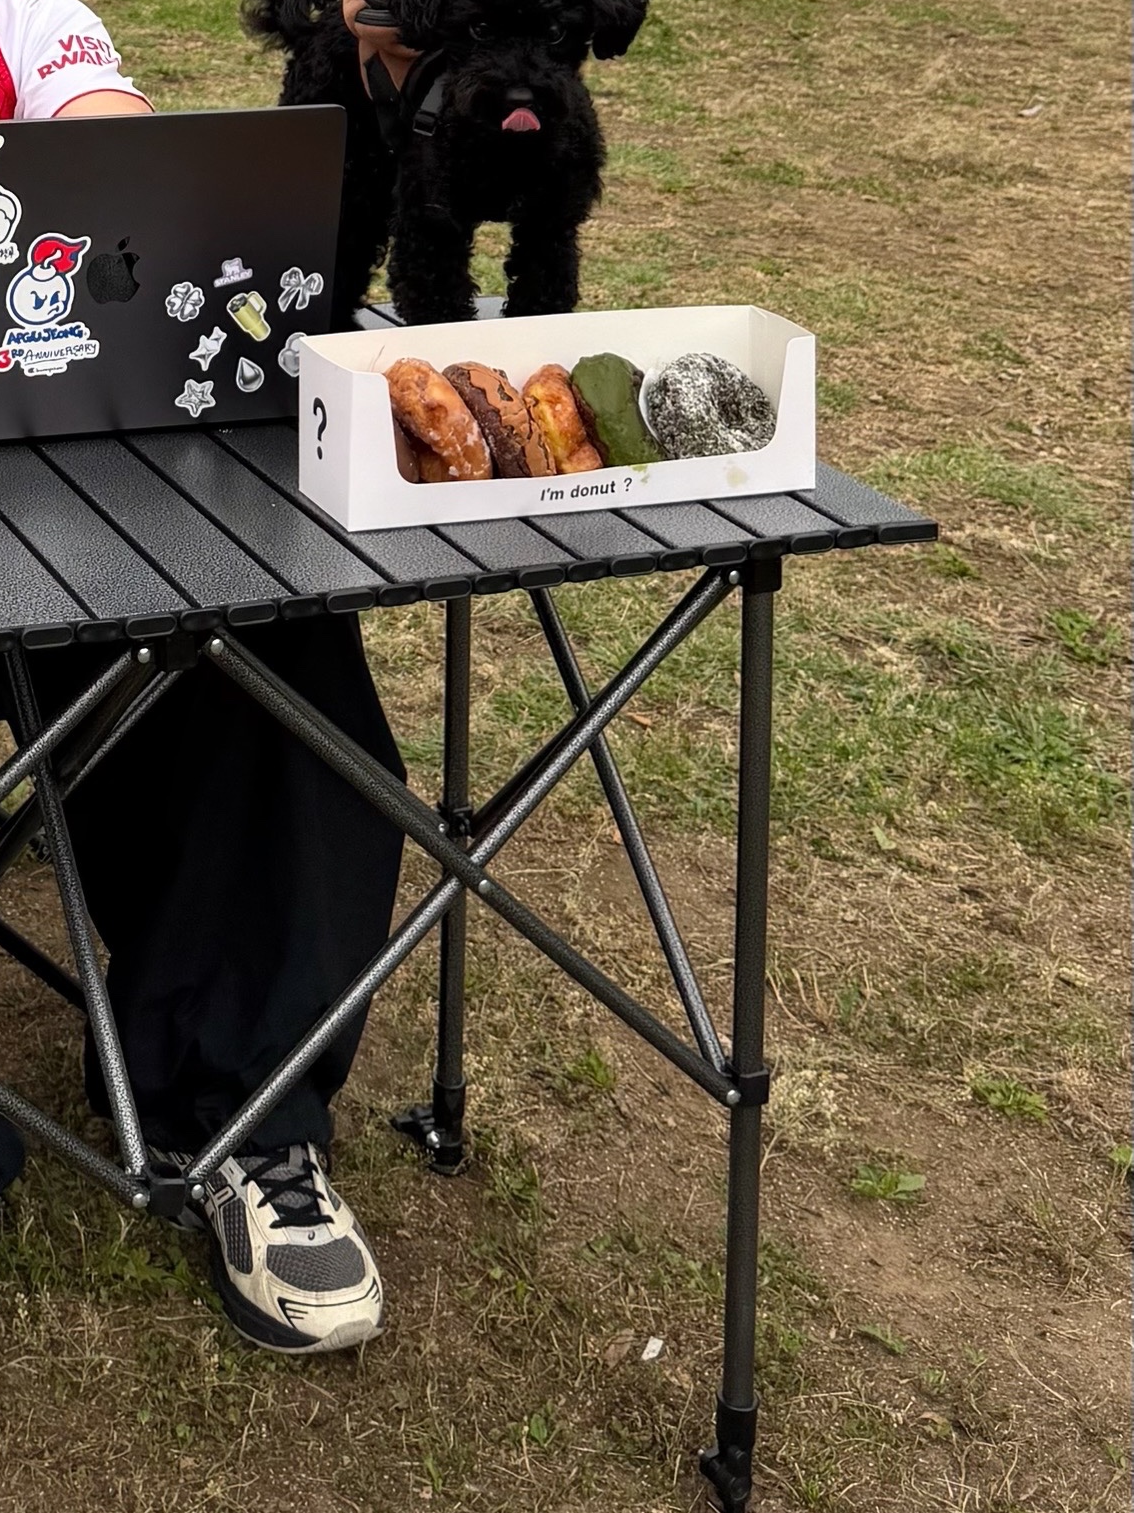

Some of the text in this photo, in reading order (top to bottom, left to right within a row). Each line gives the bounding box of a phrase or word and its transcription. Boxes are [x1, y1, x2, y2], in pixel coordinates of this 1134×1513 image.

[313, 397, 327, 460] ?
[540, 478, 632, 501] I'm donut ?
